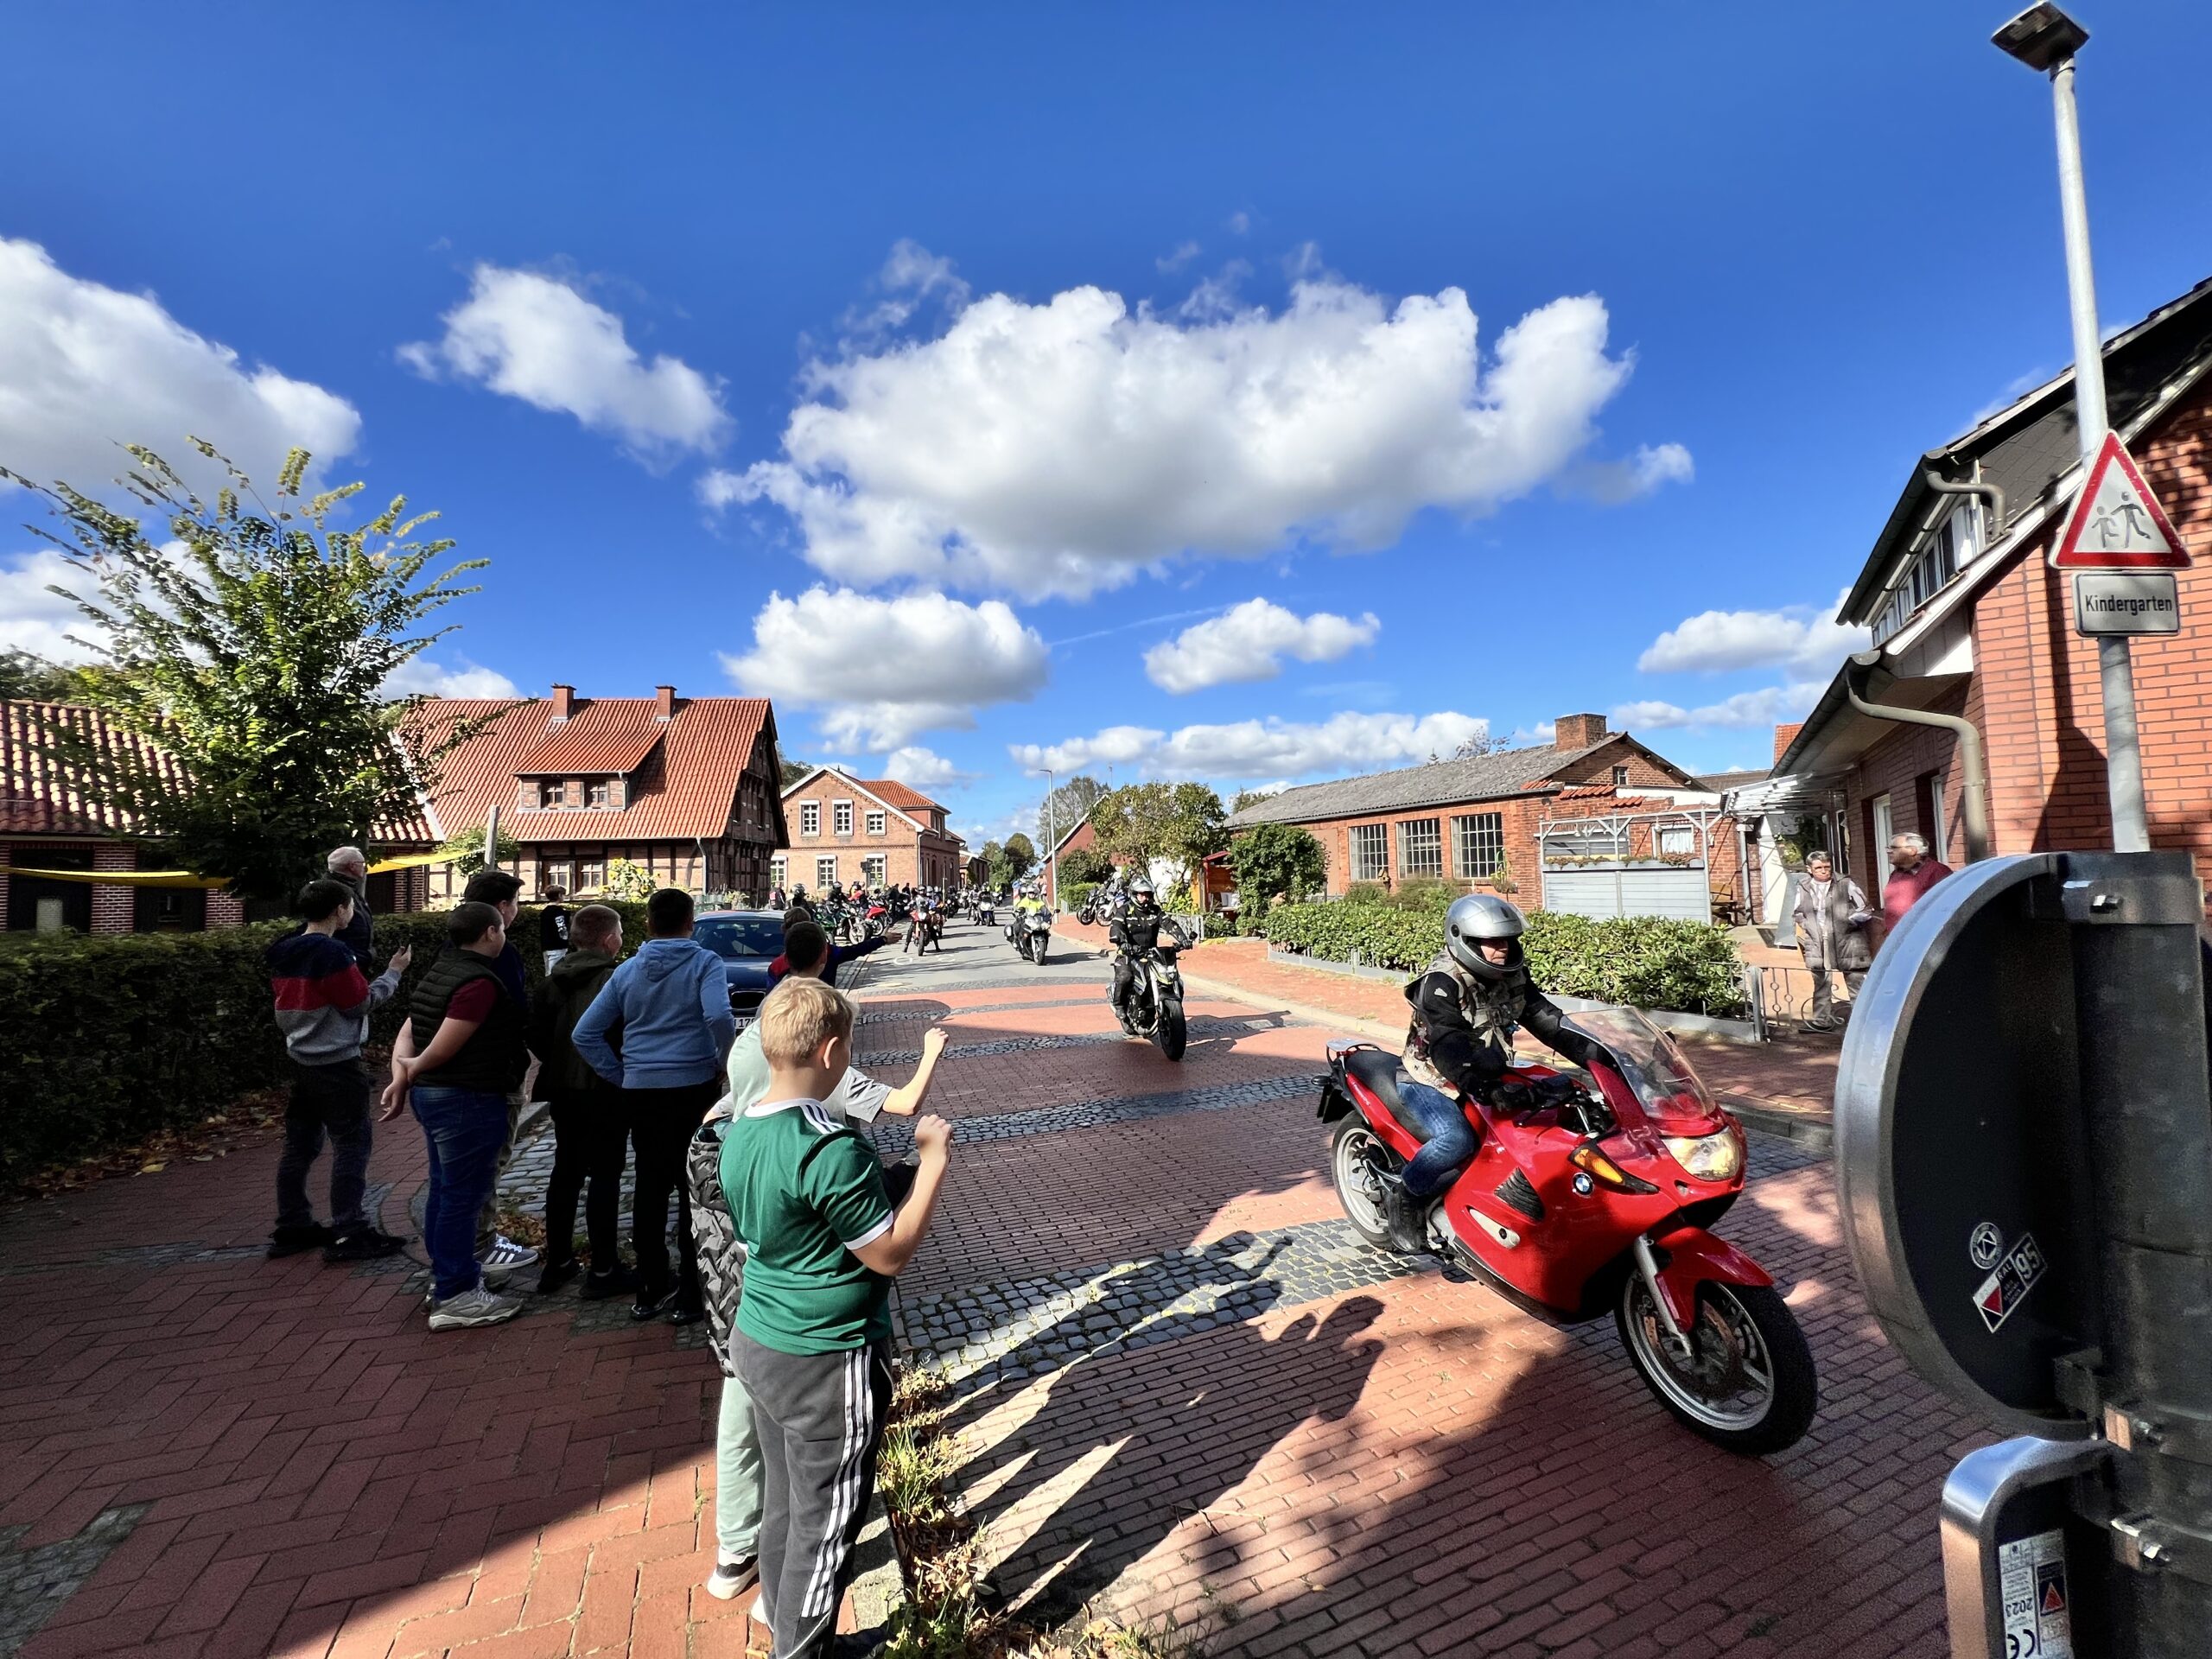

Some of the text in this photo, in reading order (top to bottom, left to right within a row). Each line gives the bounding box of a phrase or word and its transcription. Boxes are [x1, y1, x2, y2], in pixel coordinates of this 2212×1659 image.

[2085, 594, 2172, 616] Kindergarten
[1997, 1262, 2012, 1281] RAL
[2015, 1241, 2041, 1281] 95
[2005, 1598, 2033, 1618] 2023
